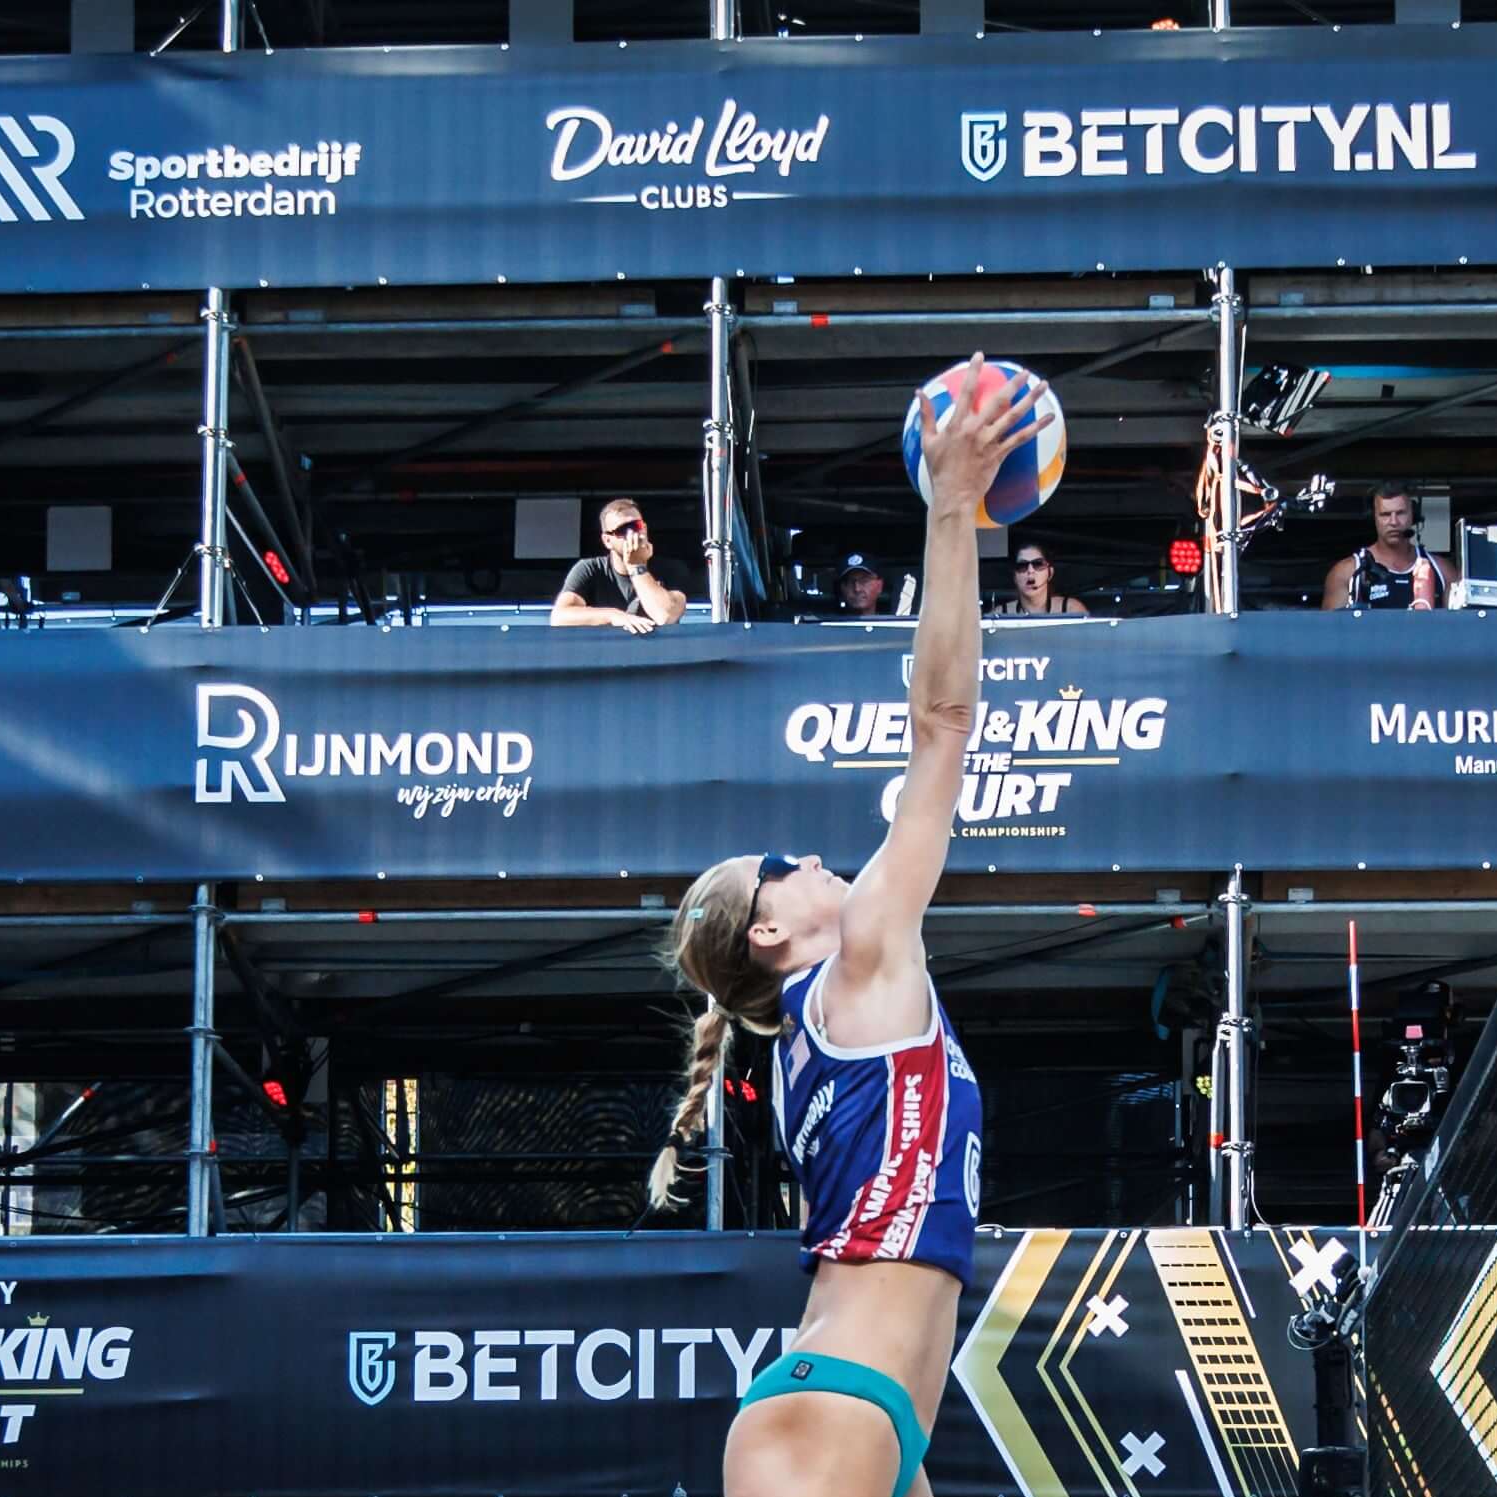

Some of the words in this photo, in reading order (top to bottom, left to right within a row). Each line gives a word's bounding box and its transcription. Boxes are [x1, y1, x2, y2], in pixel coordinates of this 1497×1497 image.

[546, 106, 704, 182] David
[705, 98, 830, 177] Lloyd
[1023, 102, 1477, 177] BETCITY.NL
[108, 141, 362, 186] Sportbedrijf
[129, 183, 336, 219] Rotterdam
[641, 184, 728, 210] CLUBS
[978, 657, 1050, 682] TCITY
[880, 772, 1072, 824] CURT
[961, 826, 1067, 837] CHAMPIONSHIPS
